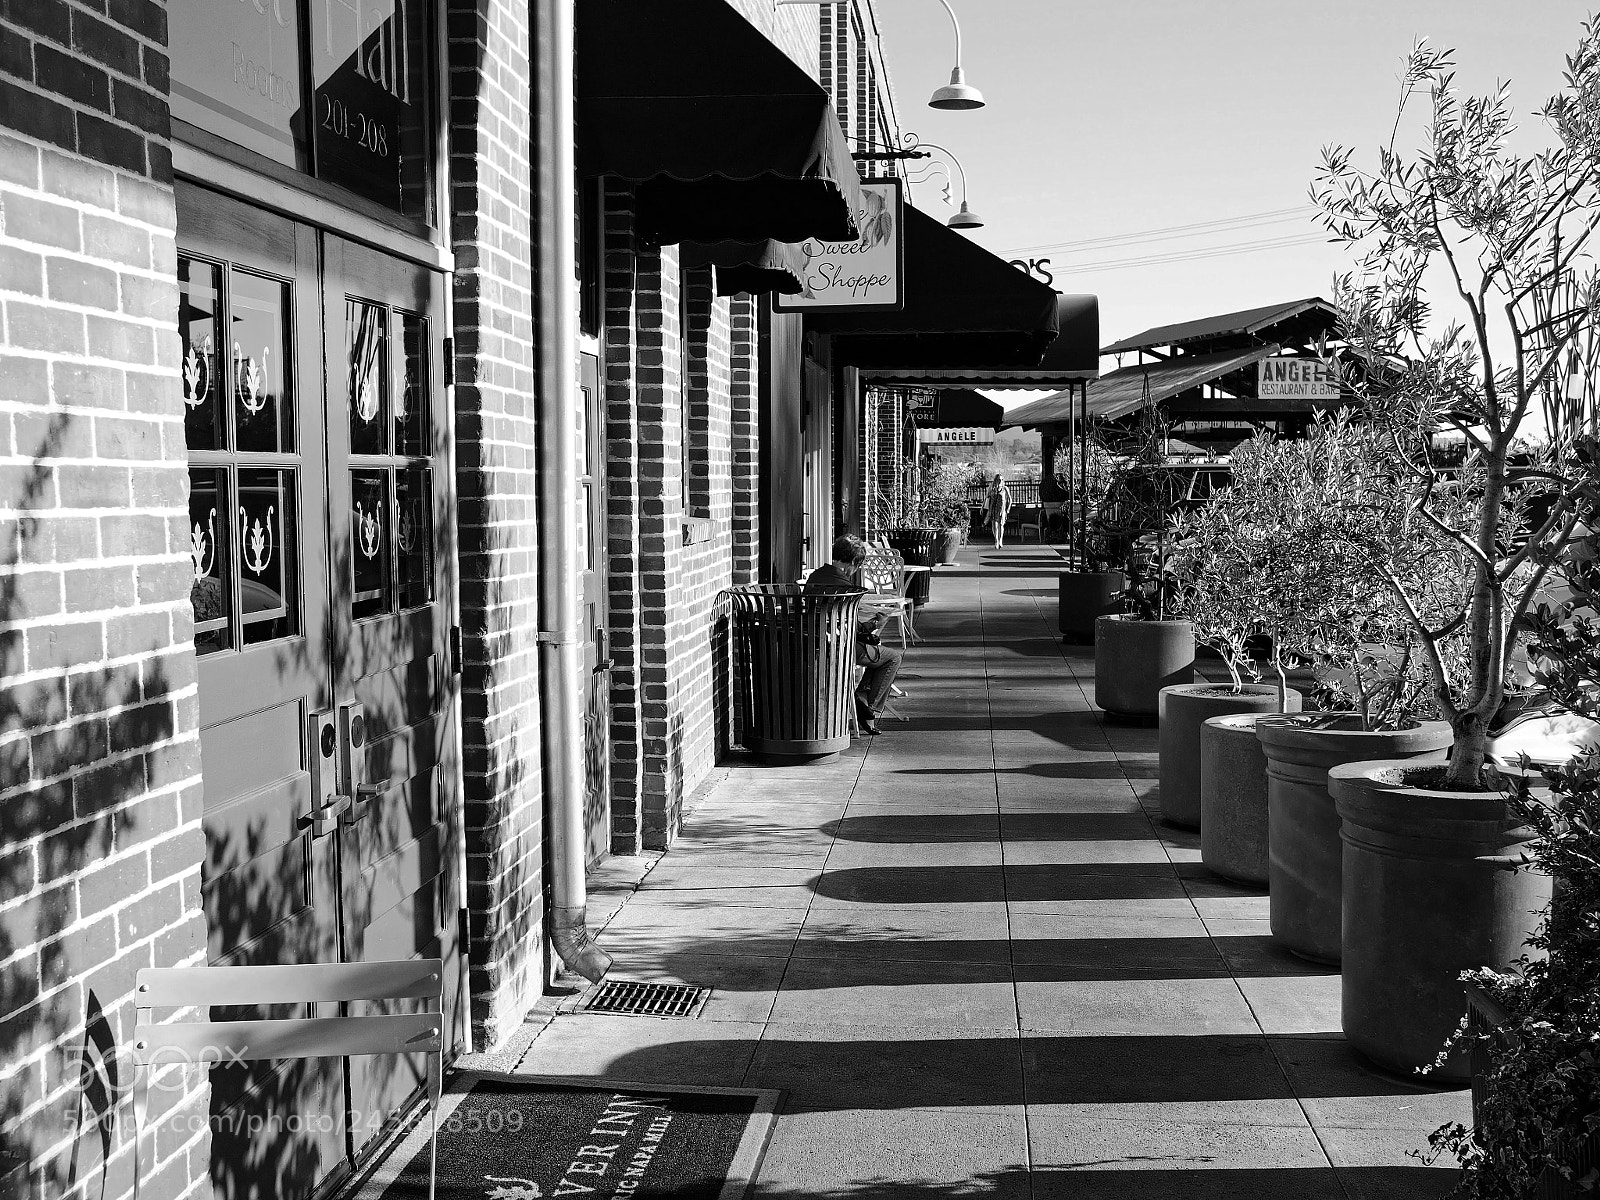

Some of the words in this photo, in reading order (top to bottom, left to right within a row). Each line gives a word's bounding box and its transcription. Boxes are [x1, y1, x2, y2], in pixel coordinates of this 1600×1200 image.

[231, 41, 295, 111] Rooms
[321, 93, 388, 157] 201-208
[802, 239, 872, 258] Sweet
[807, 263, 892, 298] Shoppe
[1262, 383, 1308, 395] RESTAURANT
[1311, 383, 1318, 395] &
[590, 1094, 670, 1136] INN
[623, 1145, 658, 1177] NAPA
[642, 1115, 672, 1142] MILL
